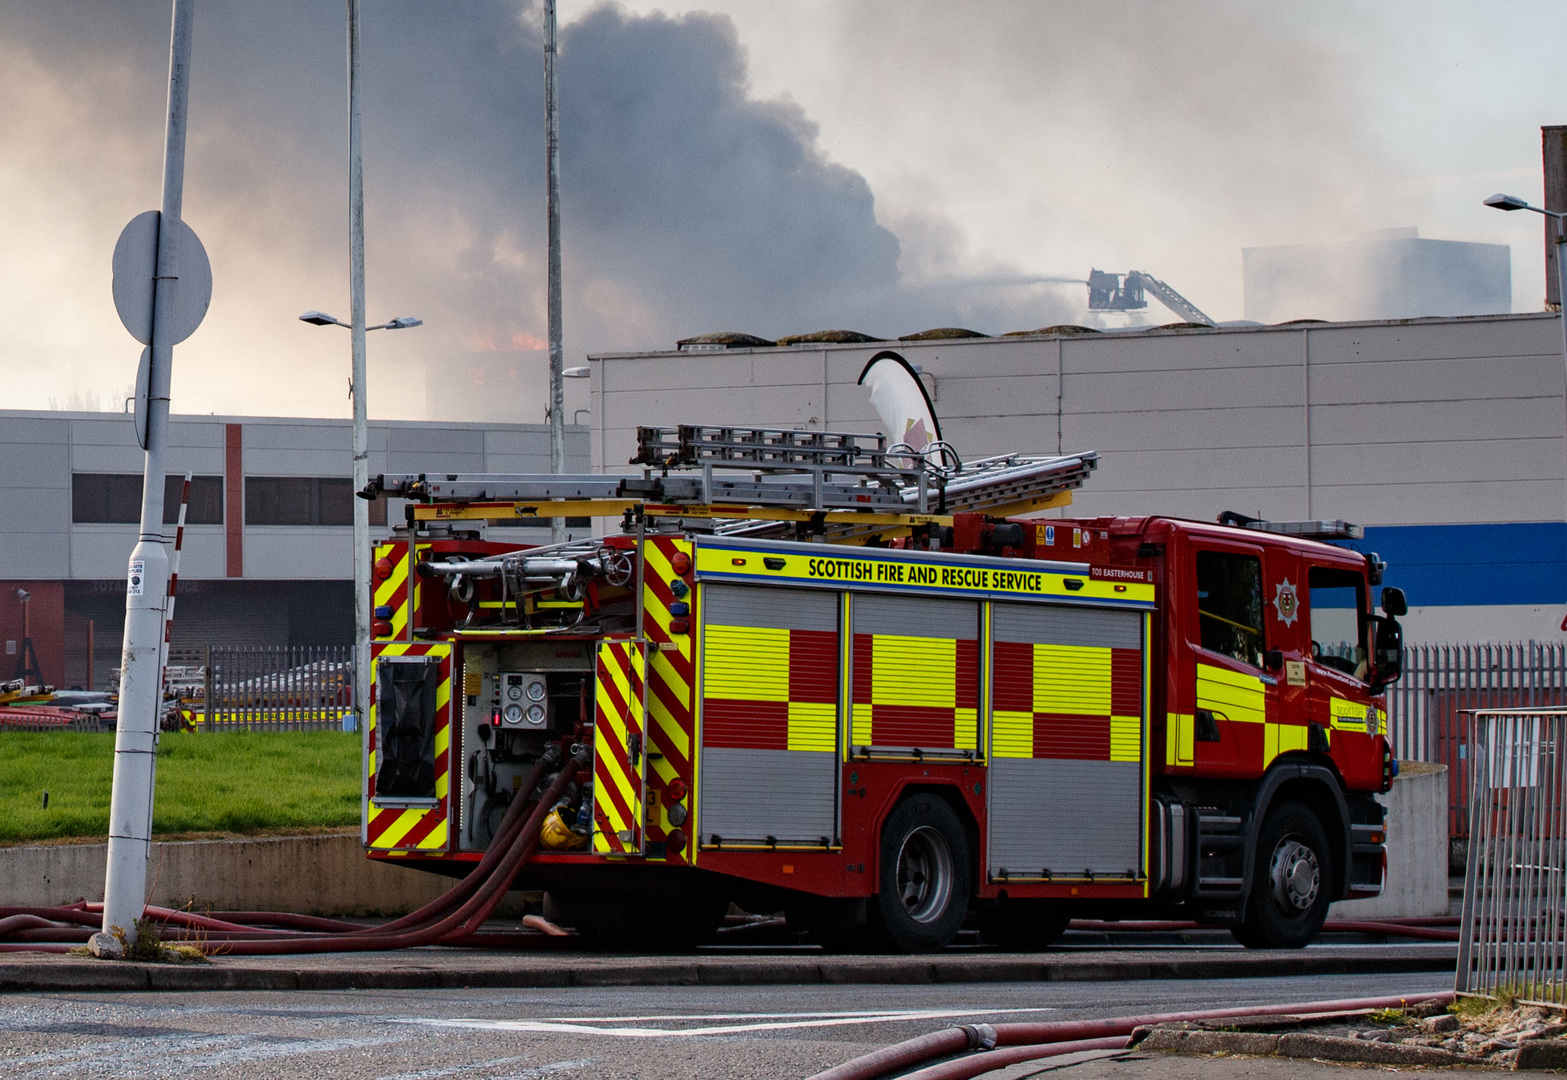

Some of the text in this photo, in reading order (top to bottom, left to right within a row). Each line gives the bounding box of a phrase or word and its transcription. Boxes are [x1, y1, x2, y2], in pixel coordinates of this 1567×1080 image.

[808, 558, 1042, 591] SCOTTISH FIRE AND RESCUE SERVICE
[1103, 569, 1145, 579] EASTERHOUSE
